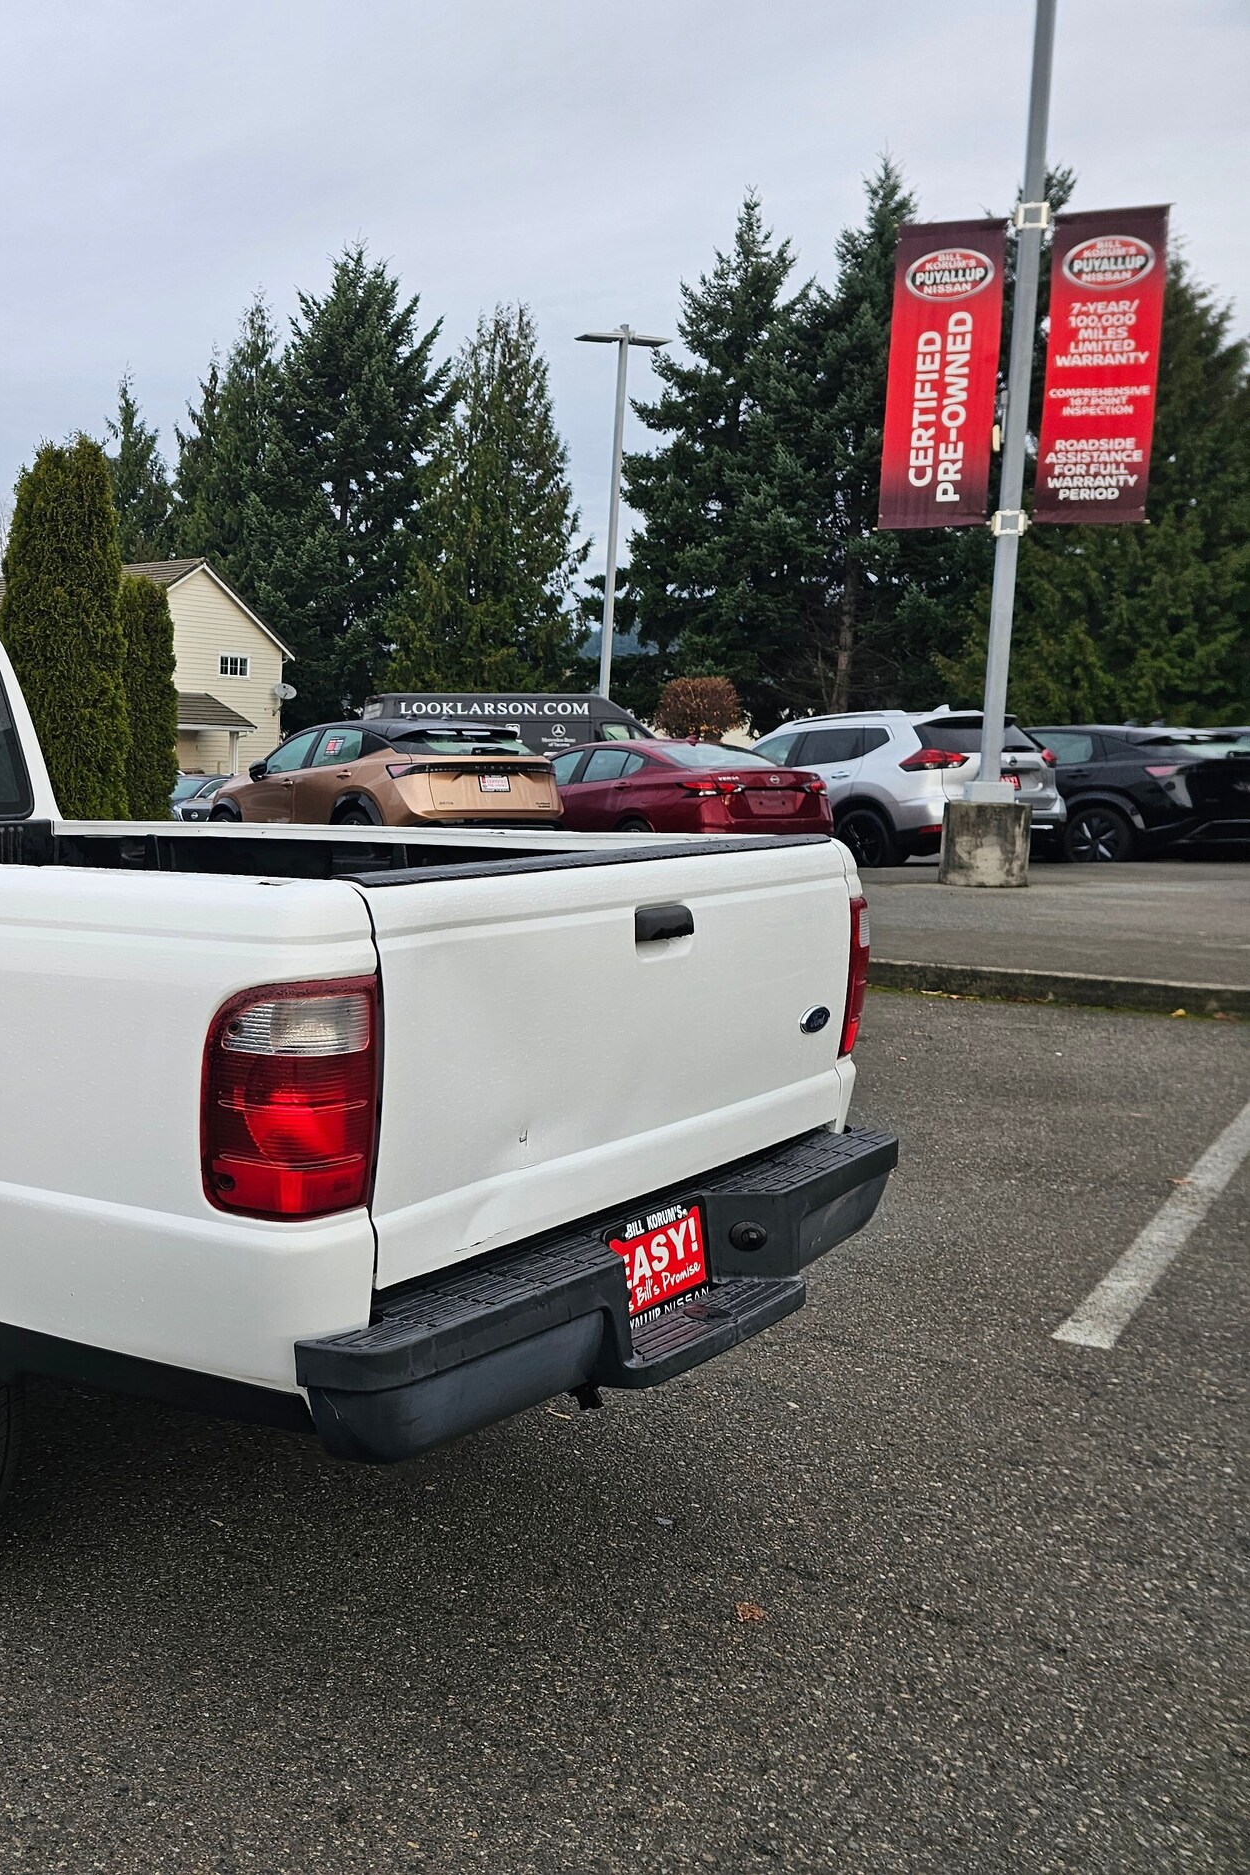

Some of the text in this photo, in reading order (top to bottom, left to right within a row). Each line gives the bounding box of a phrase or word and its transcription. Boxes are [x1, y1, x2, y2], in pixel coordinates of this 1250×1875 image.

[937, 253, 962, 262] BILL
[1072, 255, 1146, 273] PUYALLUP
[915, 267, 985, 285] PUYALLUP
[1081, 271, 1131, 282] NISSAN
[923, 283, 971, 294] NISSAN
[1070, 298, 1139, 315] 7-YEAR/
[1078, 326, 1128, 340] MILES
[1070, 339, 1135, 353] LIMITED
[1055, 351, 1149, 367] WARRANTY
[1049, 385, 1150, 398] COMPREHENSIVE
[908, 330, 942, 487] CERTIFIED
[936, 311, 973, 502] PRE-OWNED
[1062, 404, 1133, 416] INSPECTION
[1055, 437, 1136, 451] ROADSIDE
[1044, 449, 1143, 464] ASSISTANCE
[1053, 462, 1129, 475] FOR FULL
[1047, 474, 1138, 488] WARRANTY
[1058, 487, 1119, 500] PERIOD
[400, 702, 590, 715] LOOKLARSON.COM
[625, 1204, 682, 1240] BILL KORUM'S
[635, 1279, 661, 1307] Bill's
[661, 1261, 701, 1292] Promise
